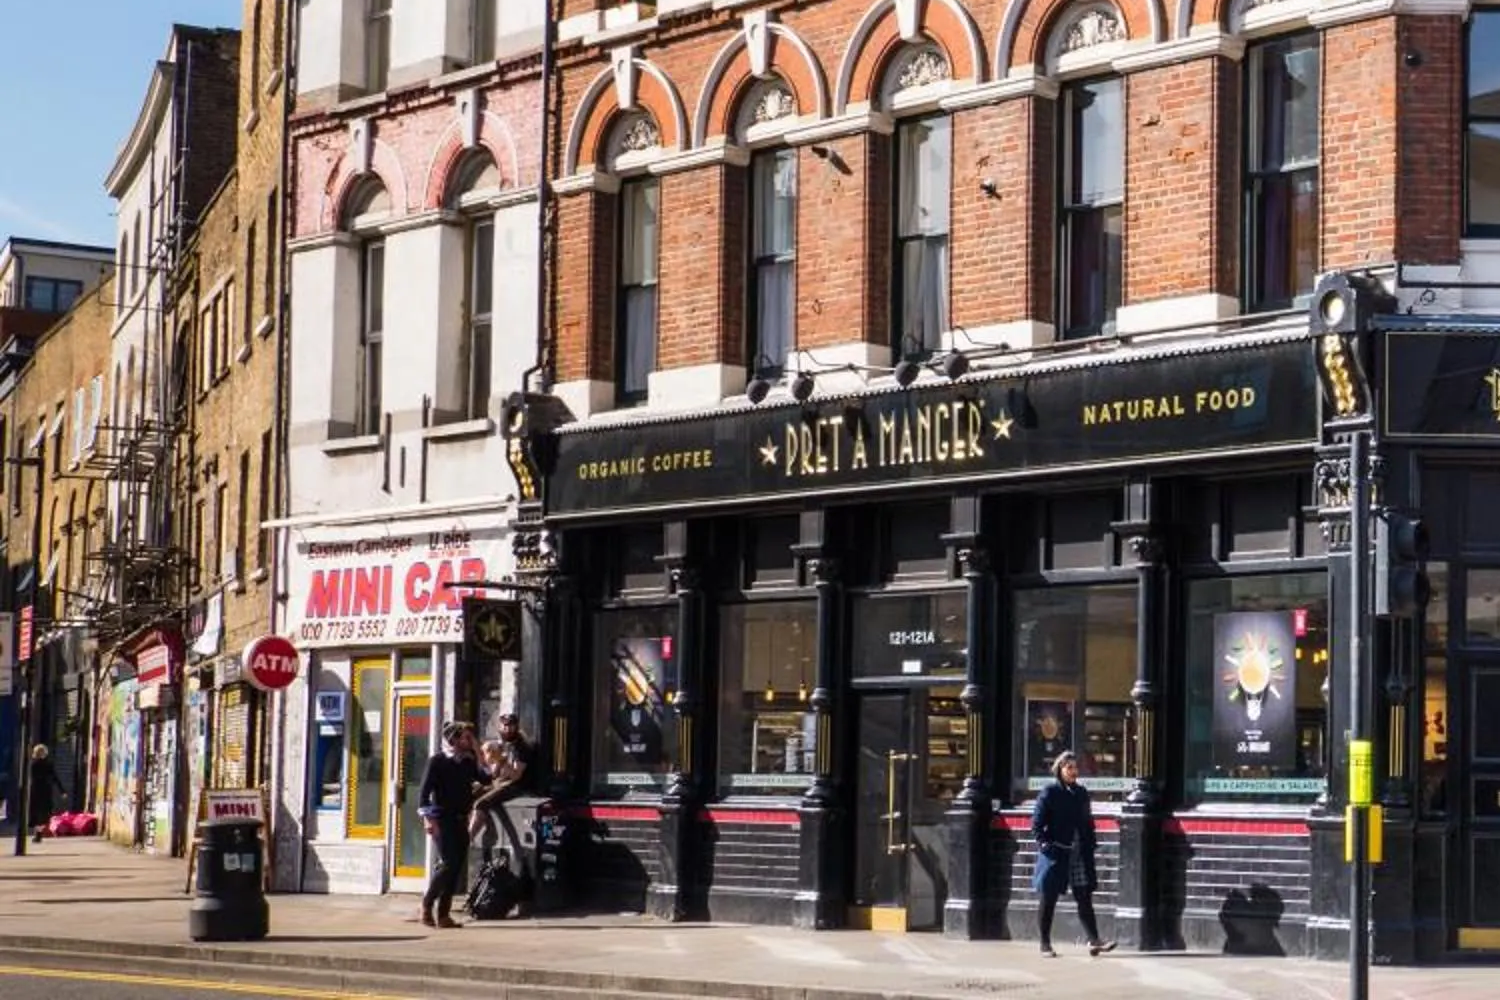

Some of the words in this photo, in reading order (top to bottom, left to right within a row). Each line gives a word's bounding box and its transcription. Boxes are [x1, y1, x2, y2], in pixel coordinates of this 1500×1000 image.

[1083, 395, 1185, 425] NATURAL
[1195, 387, 1256, 413] FOOD
[785, 415, 844, 477] PRET
[851, 416, 869, 470] A
[879, 401, 985, 467] MANGER
[579, 457, 646, 480] ORGANIC
[652, 449, 713, 472] COFFEE
[306, 564, 393, 619] MINI
[404, 557, 487, 614] CAB
[327, 621, 355, 641] 7739
[396, 617, 418, 637] 020
[422, 615, 450, 635] 7739
[253, 652, 298, 674] ATM
[213, 803, 257, 817] MINI
